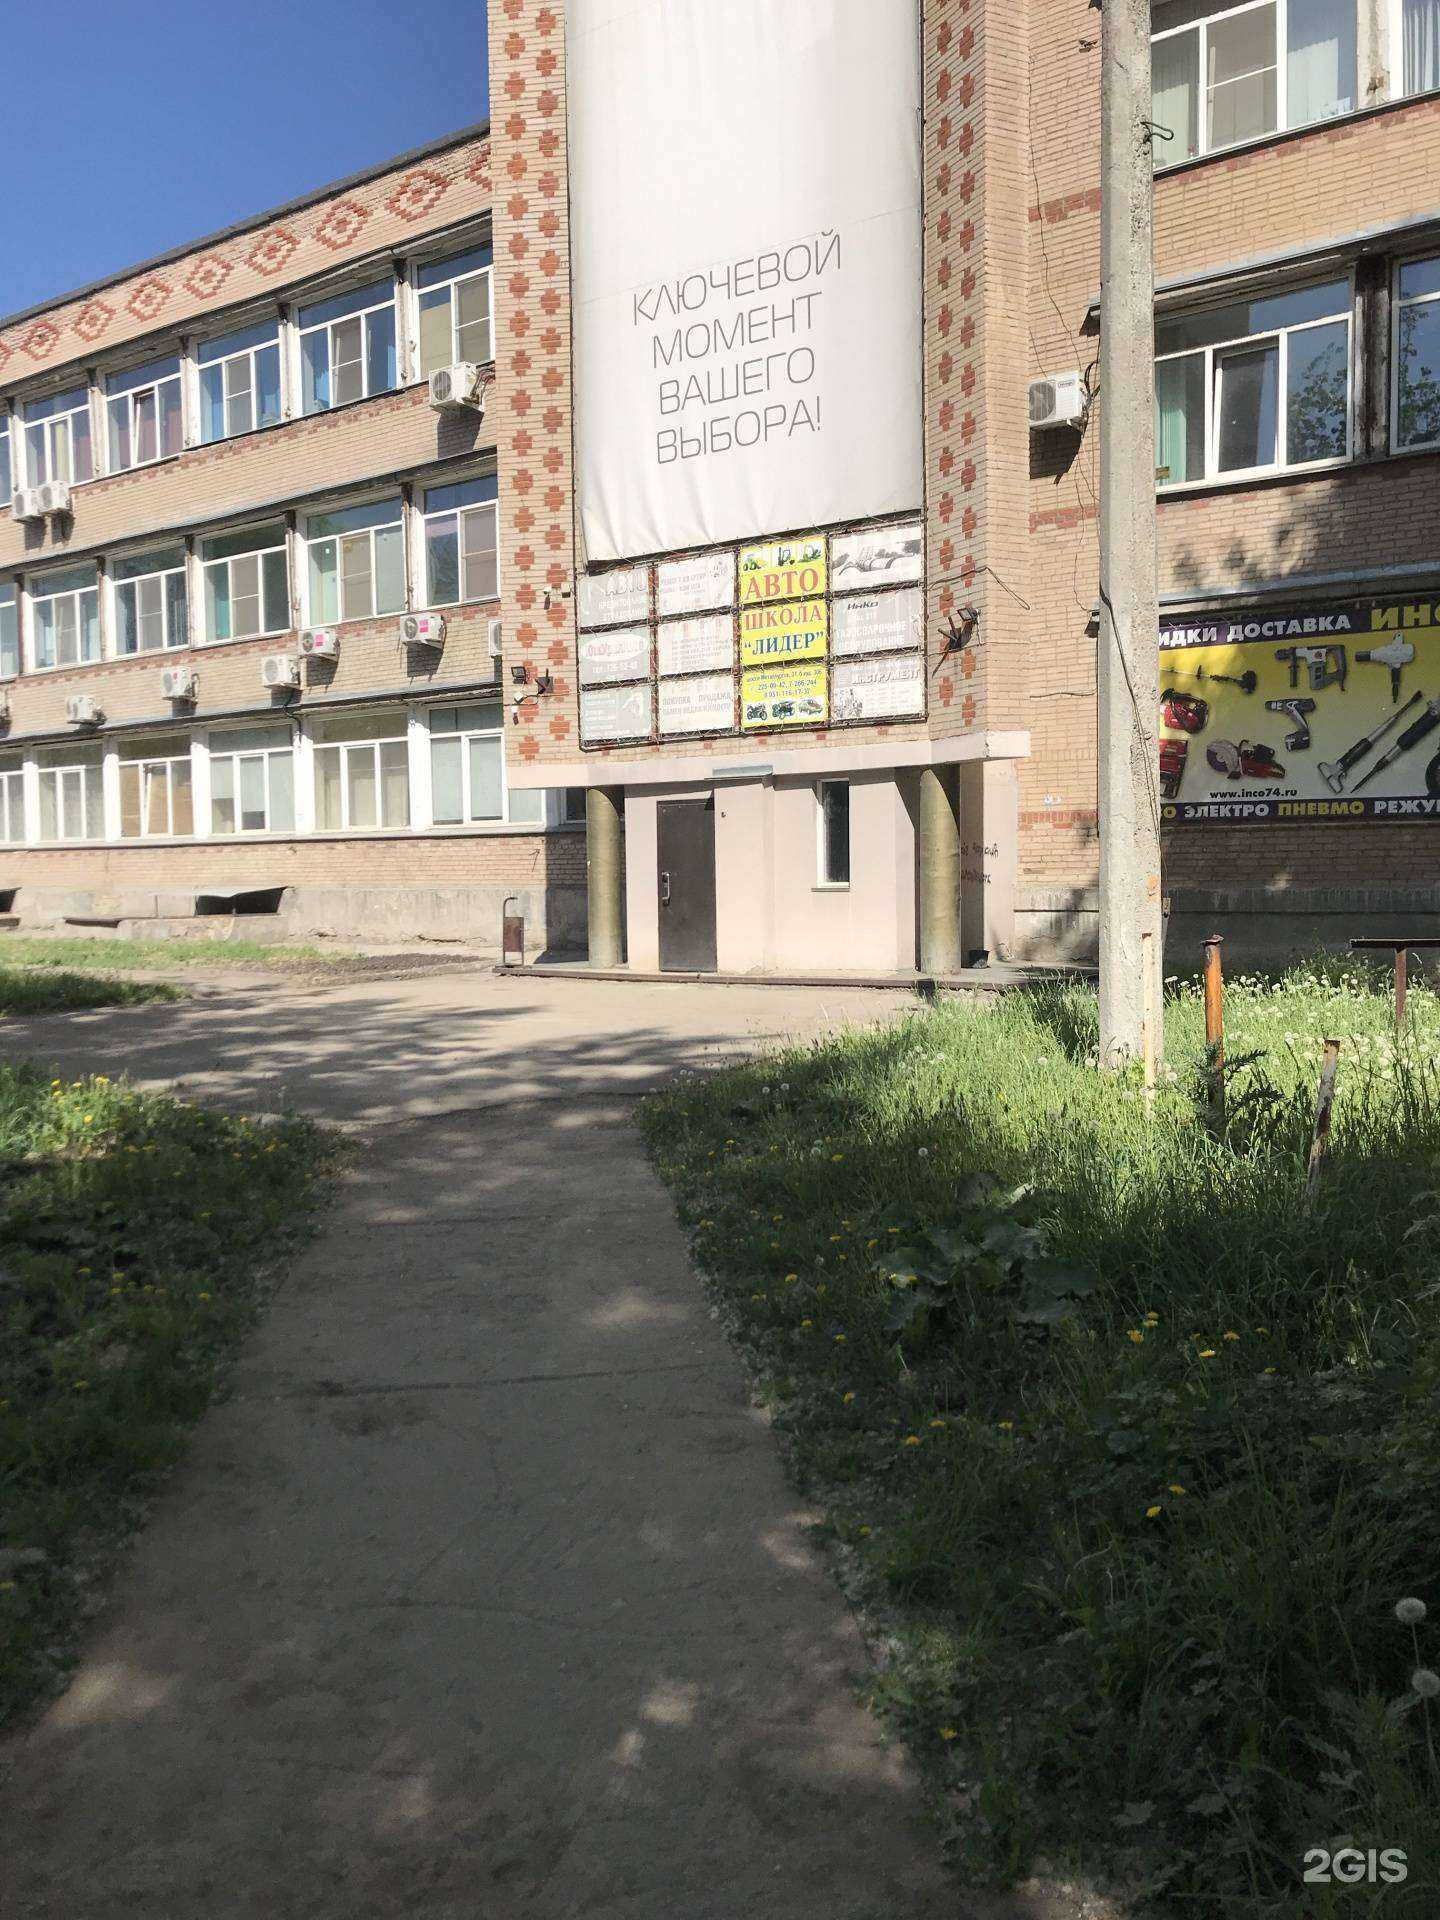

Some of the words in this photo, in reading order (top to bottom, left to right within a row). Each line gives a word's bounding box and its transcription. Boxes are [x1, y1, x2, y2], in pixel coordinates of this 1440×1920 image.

[633, 229, 841, 326] КЛЮЧЕВОЙ
[653, 291, 823, 369] МОМЕНТ
[659, 347, 815, 416] ВАШЕГО
[656, 395, 822, 465] ВЫБОРА!
[745, 568, 819, 601] АВТО
[744, 604, 823, 631] ШКОЛА
[1226, 614, 1351, 643] ДОСТАВКА
[1184, 802, 1270, 818] ЭЛЕКТРО
[1277, 800, 1365, 816] ПНЕВМО
[1209, 787, 1298, 798] www.inco74.ru
